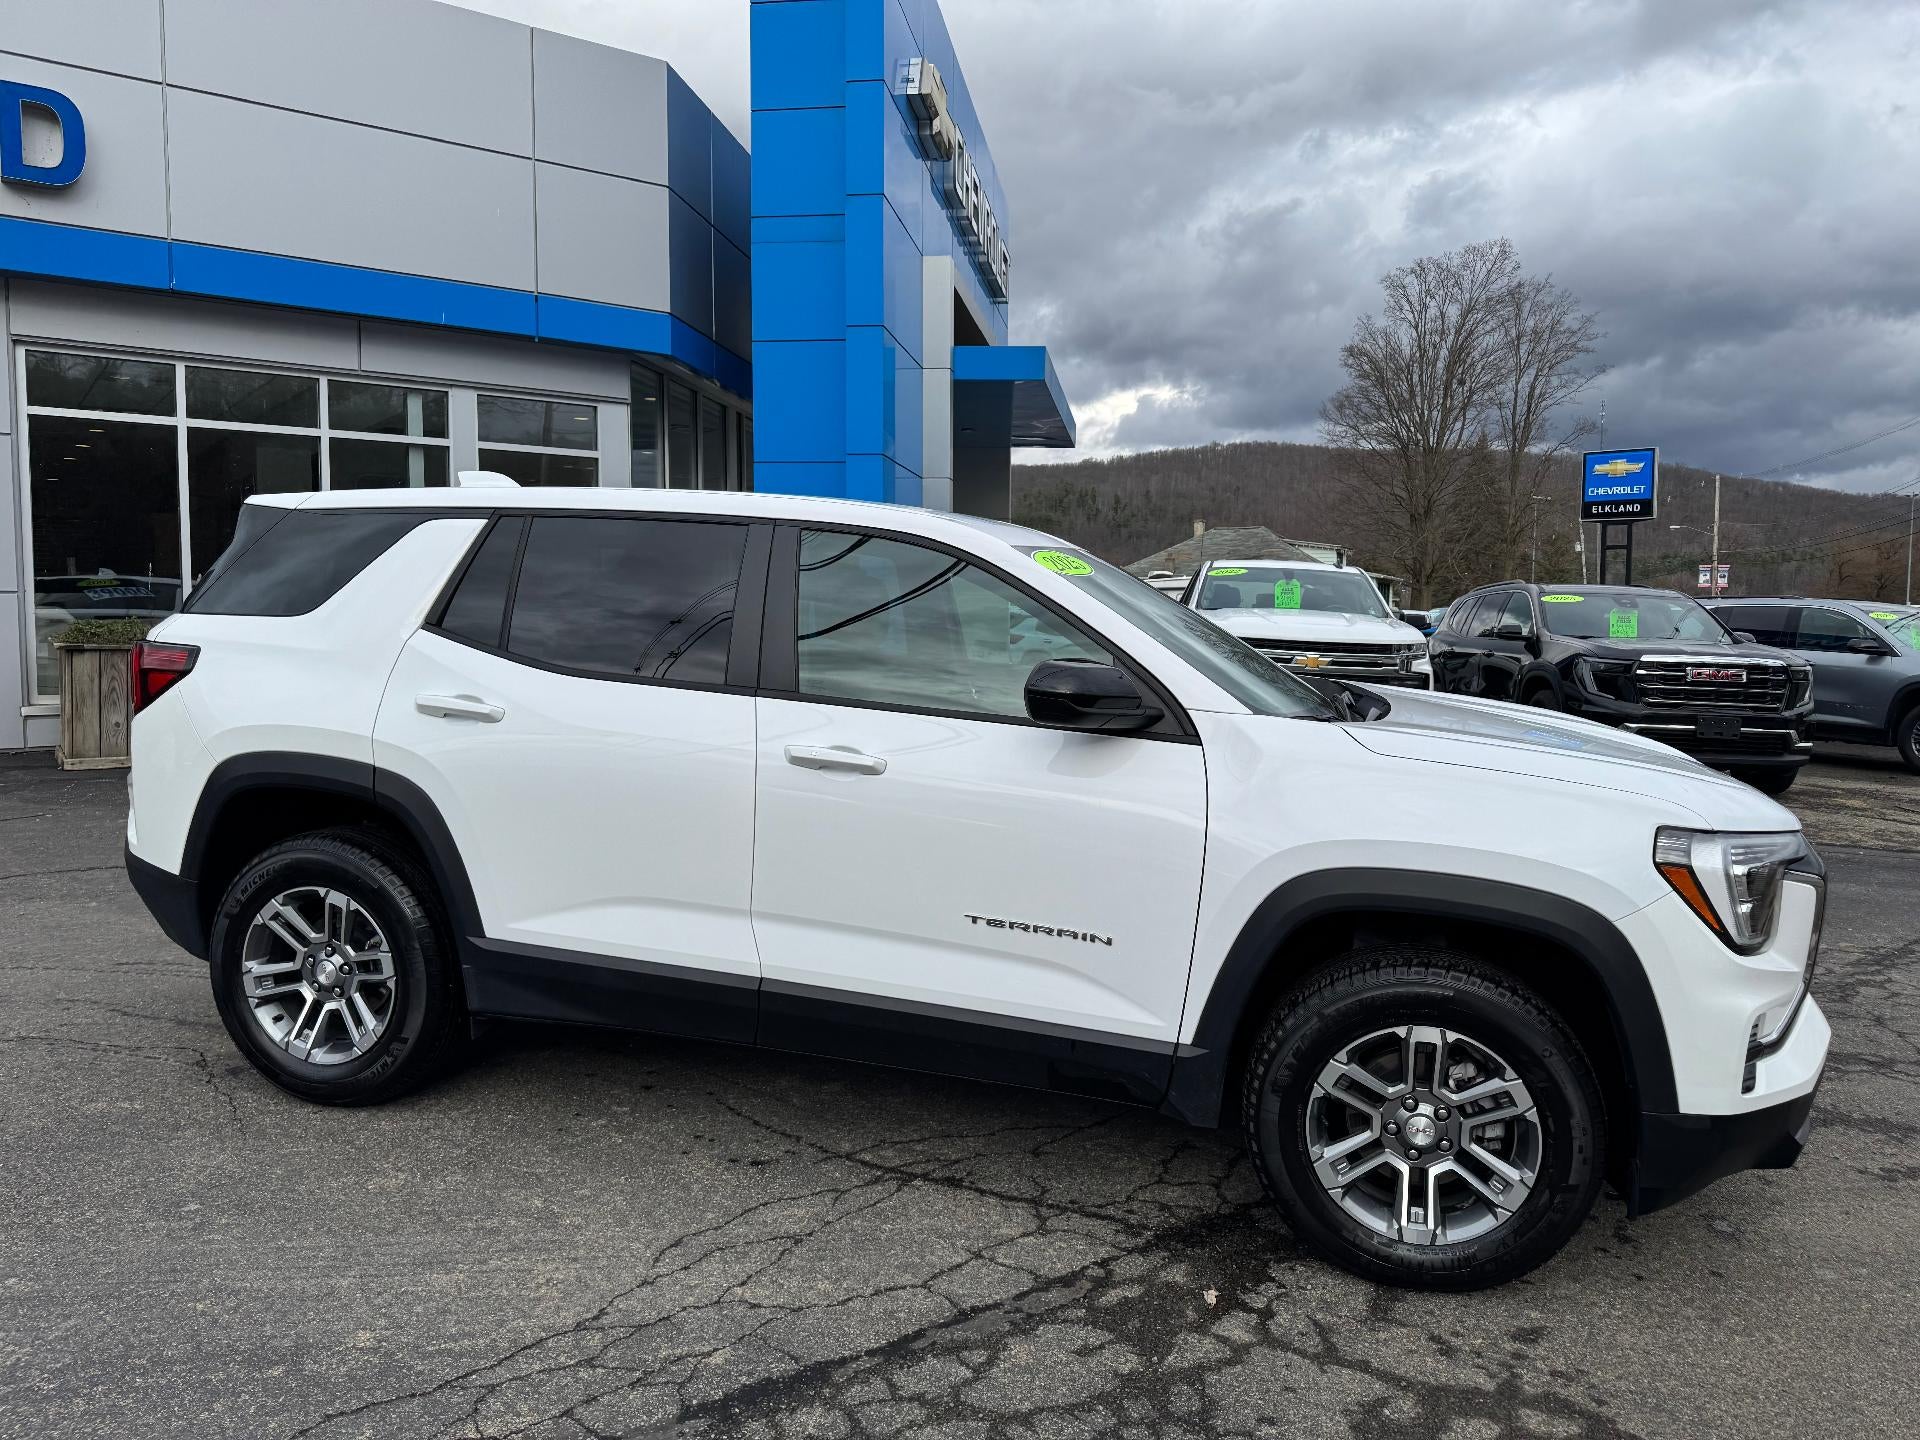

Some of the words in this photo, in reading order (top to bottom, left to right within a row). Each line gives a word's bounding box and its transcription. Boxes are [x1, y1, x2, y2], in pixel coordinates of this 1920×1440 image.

[1588, 484, 1646, 496] CHEVROLET
[1592, 503, 1641, 514] ELKLAND
[1042, 555, 1087, 571] 2025
[1685, 667, 1747, 683] GMC
[963, 913, 1113, 947] TERRAIN
